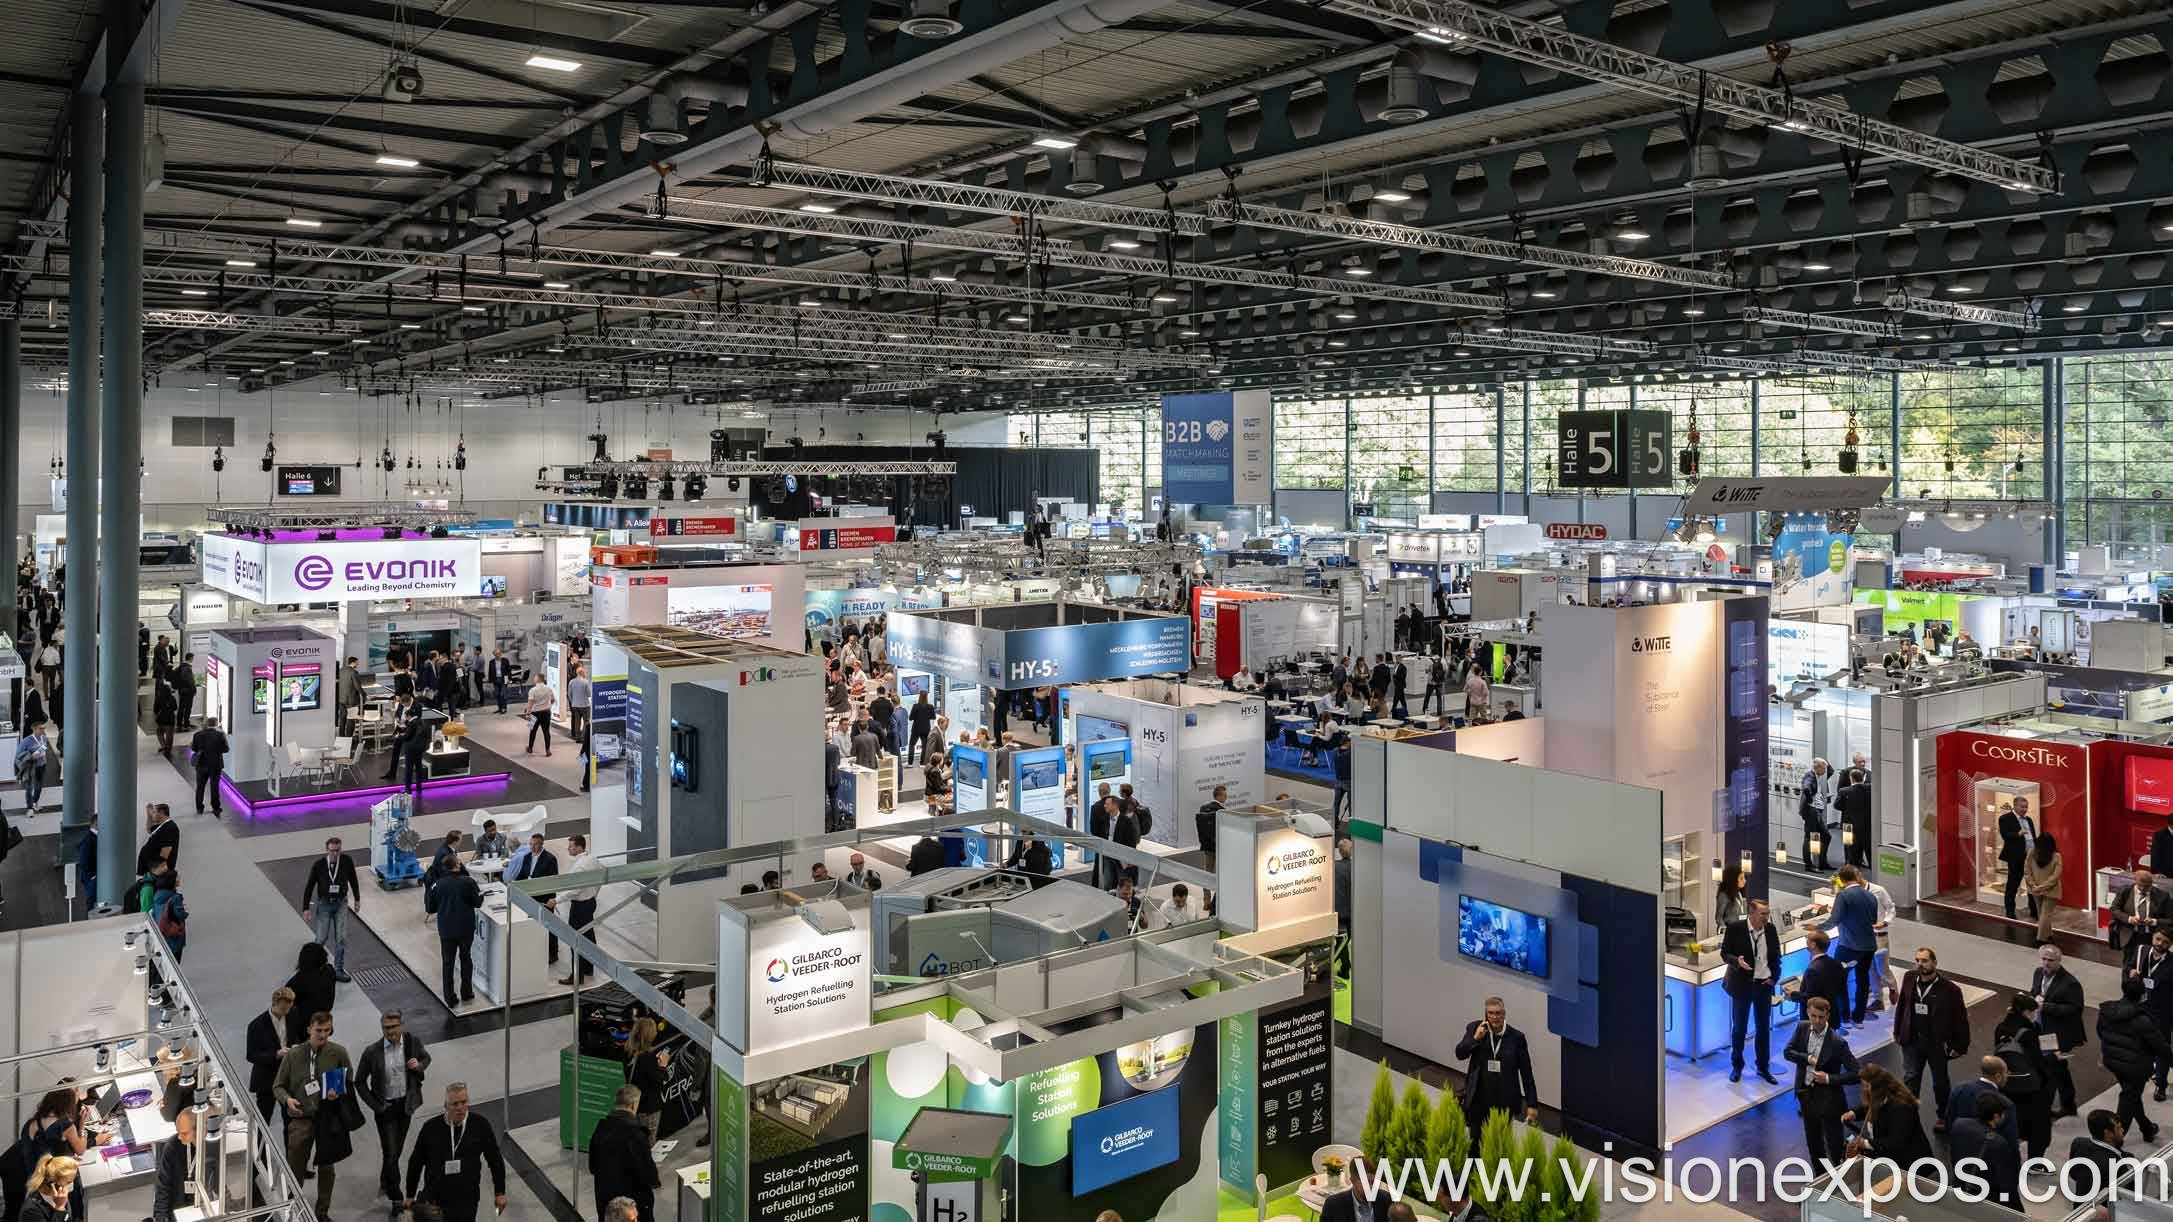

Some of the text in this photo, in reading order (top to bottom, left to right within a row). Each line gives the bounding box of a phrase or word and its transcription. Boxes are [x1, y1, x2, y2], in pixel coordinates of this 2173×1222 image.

[1166, 421, 1202, 443] B2B
[1166, 447, 1229, 458] MATCHMAKING
[1563, 428, 1577, 474] Halle
[1588, 431, 1612, 474] 5
[1631, 426, 1640, 474] Halle
[1648, 431, 1664, 474] 5
[285, 472, 312, 480] Halle 6
[1550, 525, 1604, 540] HYDAC
[242, 556, 263, 583] EVONIK
[344, 559, 457, 581] EVONIK
[346, 581, 456, 593] Leading Beyond Chemistry
[852, 601, 886, 611] READY
[285, 647, 321, 656] EVONIK
[889, 640, 915, 661] HY-5
[1011, 660, 1052, 681] HY-5
[1241, 705, 1258, 716] HY-5
[1143, 727, 1165, 744] HY-5
[1282, 848, 1315, 862] GILBARCO
[1282, 855, 1327, 872] VEEDER-ROOT
[1267, 880, 1294, 893] Hydrogen
[1272, 885, 1318, 901] Station Solutions
[791, 947, 842, 965] GILBARCO
[791, 954, 862, 977] VEEDER-ROOT
[766, 979, 855, 1006] Hydrogen Refuelling
[773, 992, 847, 1015] Station Solutions
[1263, 1009, 1325, 1034] Turnkey hydrogen
[1266, 1022, 1323, 1046] station solutions
[1265, 1034, 1323, 1058] from the experts
[1262, 1044, 1326, 1072] in alternative fuels
[1030, 1071, 1080, 1093] Refuelling
[1262, 1077, 1278, 1089] YOUR
[1300, 1067, 1315, 1079] YOUR
[1315, 1062, 1327, 1072] WAY
[1037, 1087, 1073, 1105] Station
[1032, 1102, 1077, 1122] Solutions
[1114, 1126, 1143, 1141] GILBARCO
[1114, 1129, 1153, 1149] VEEDER-ROOT
[923, 1154, 962, 1165] GILBARCO
[924, 1162, 977, 1174] VEEDER-ROOT
[757, 1164, 859, 1201] modular hydrogen
[761, 1180, 855, 1215] refuelling station
[784, 1201, 835, 1222] solutions
